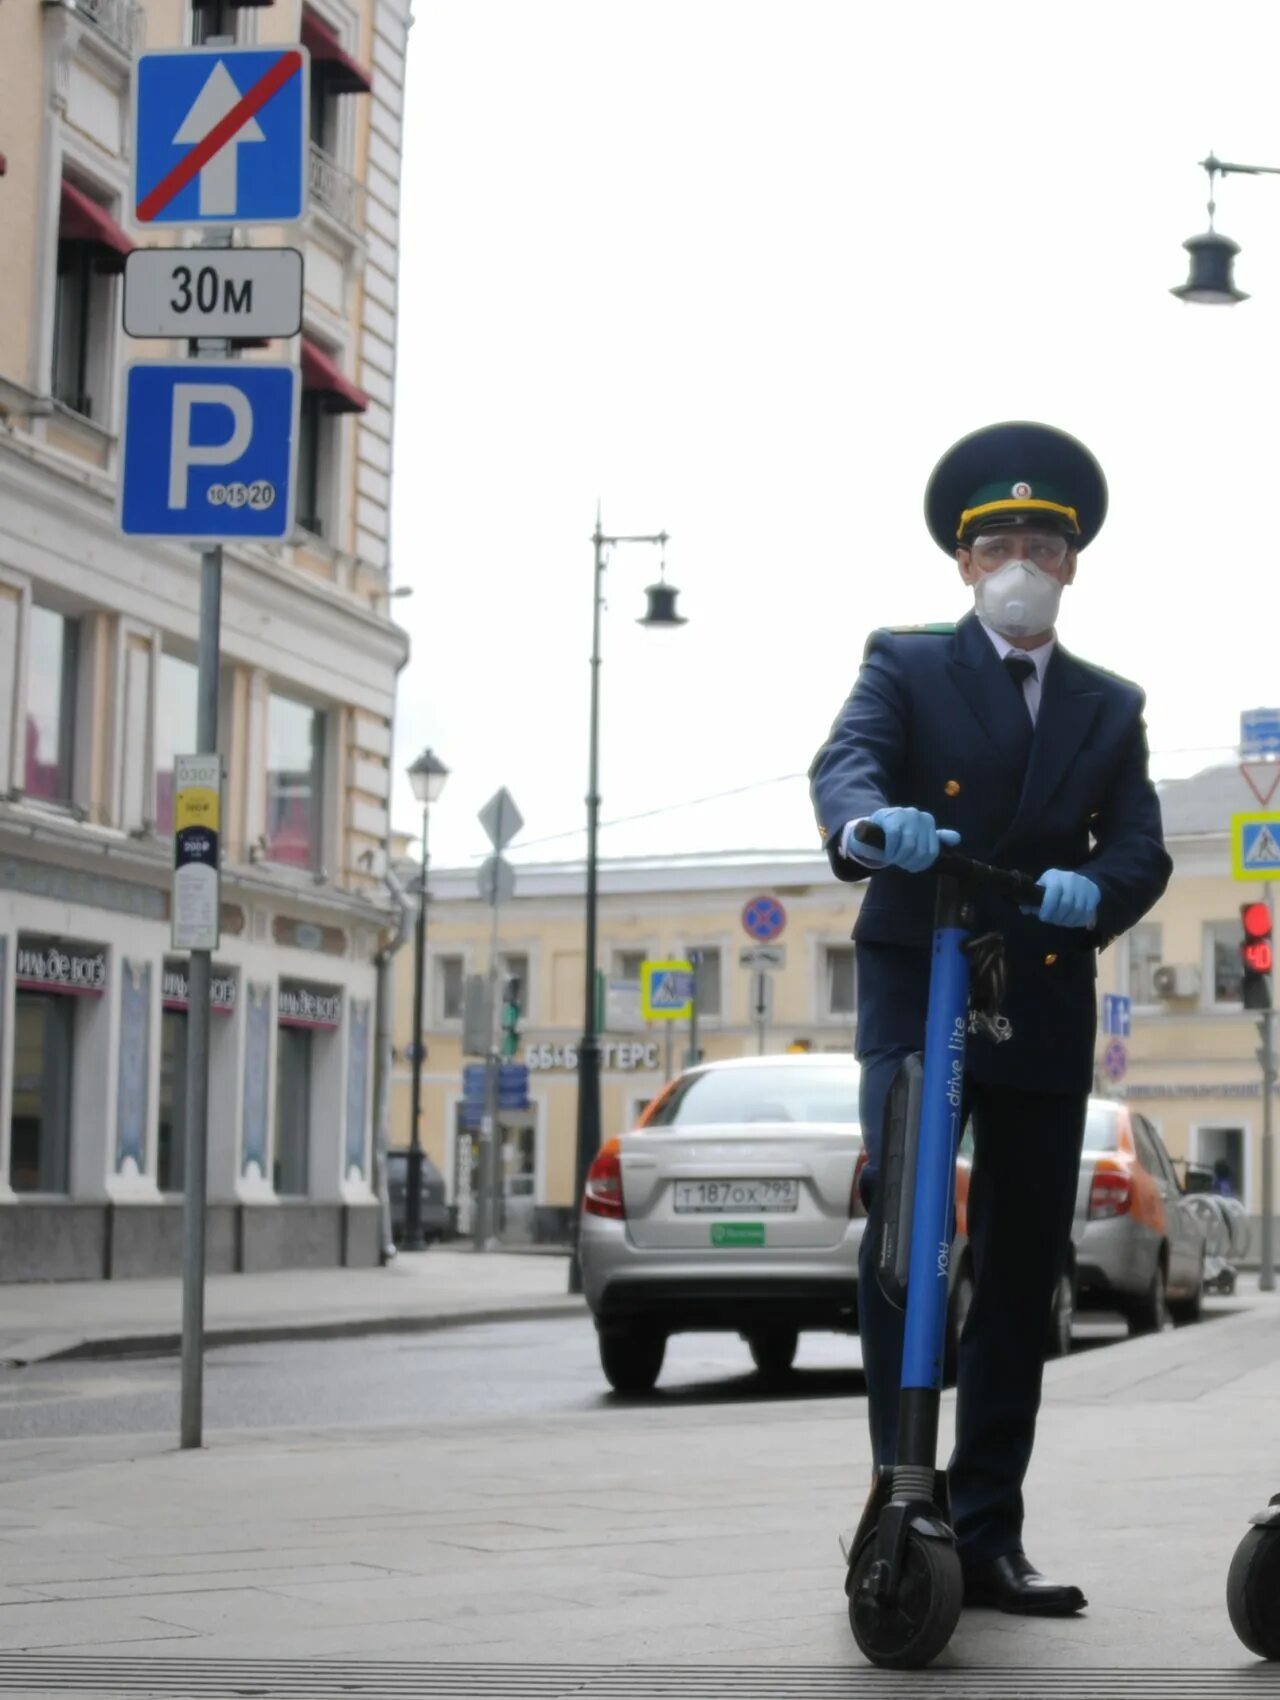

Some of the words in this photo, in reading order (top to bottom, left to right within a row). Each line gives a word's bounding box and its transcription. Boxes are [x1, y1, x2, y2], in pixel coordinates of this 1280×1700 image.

[168, 382, 253, 510] P
[228, 485, 245, 502] 15
[251, 485, 272, 503] 20
[180, 767, 216, 781] 0307
[1247, 944, 1271, 969] 40
[947, 1016, 965, 1050] lite
[945, 1059, 962, 1107] drive
[936, 1241, 949, 1277] you
